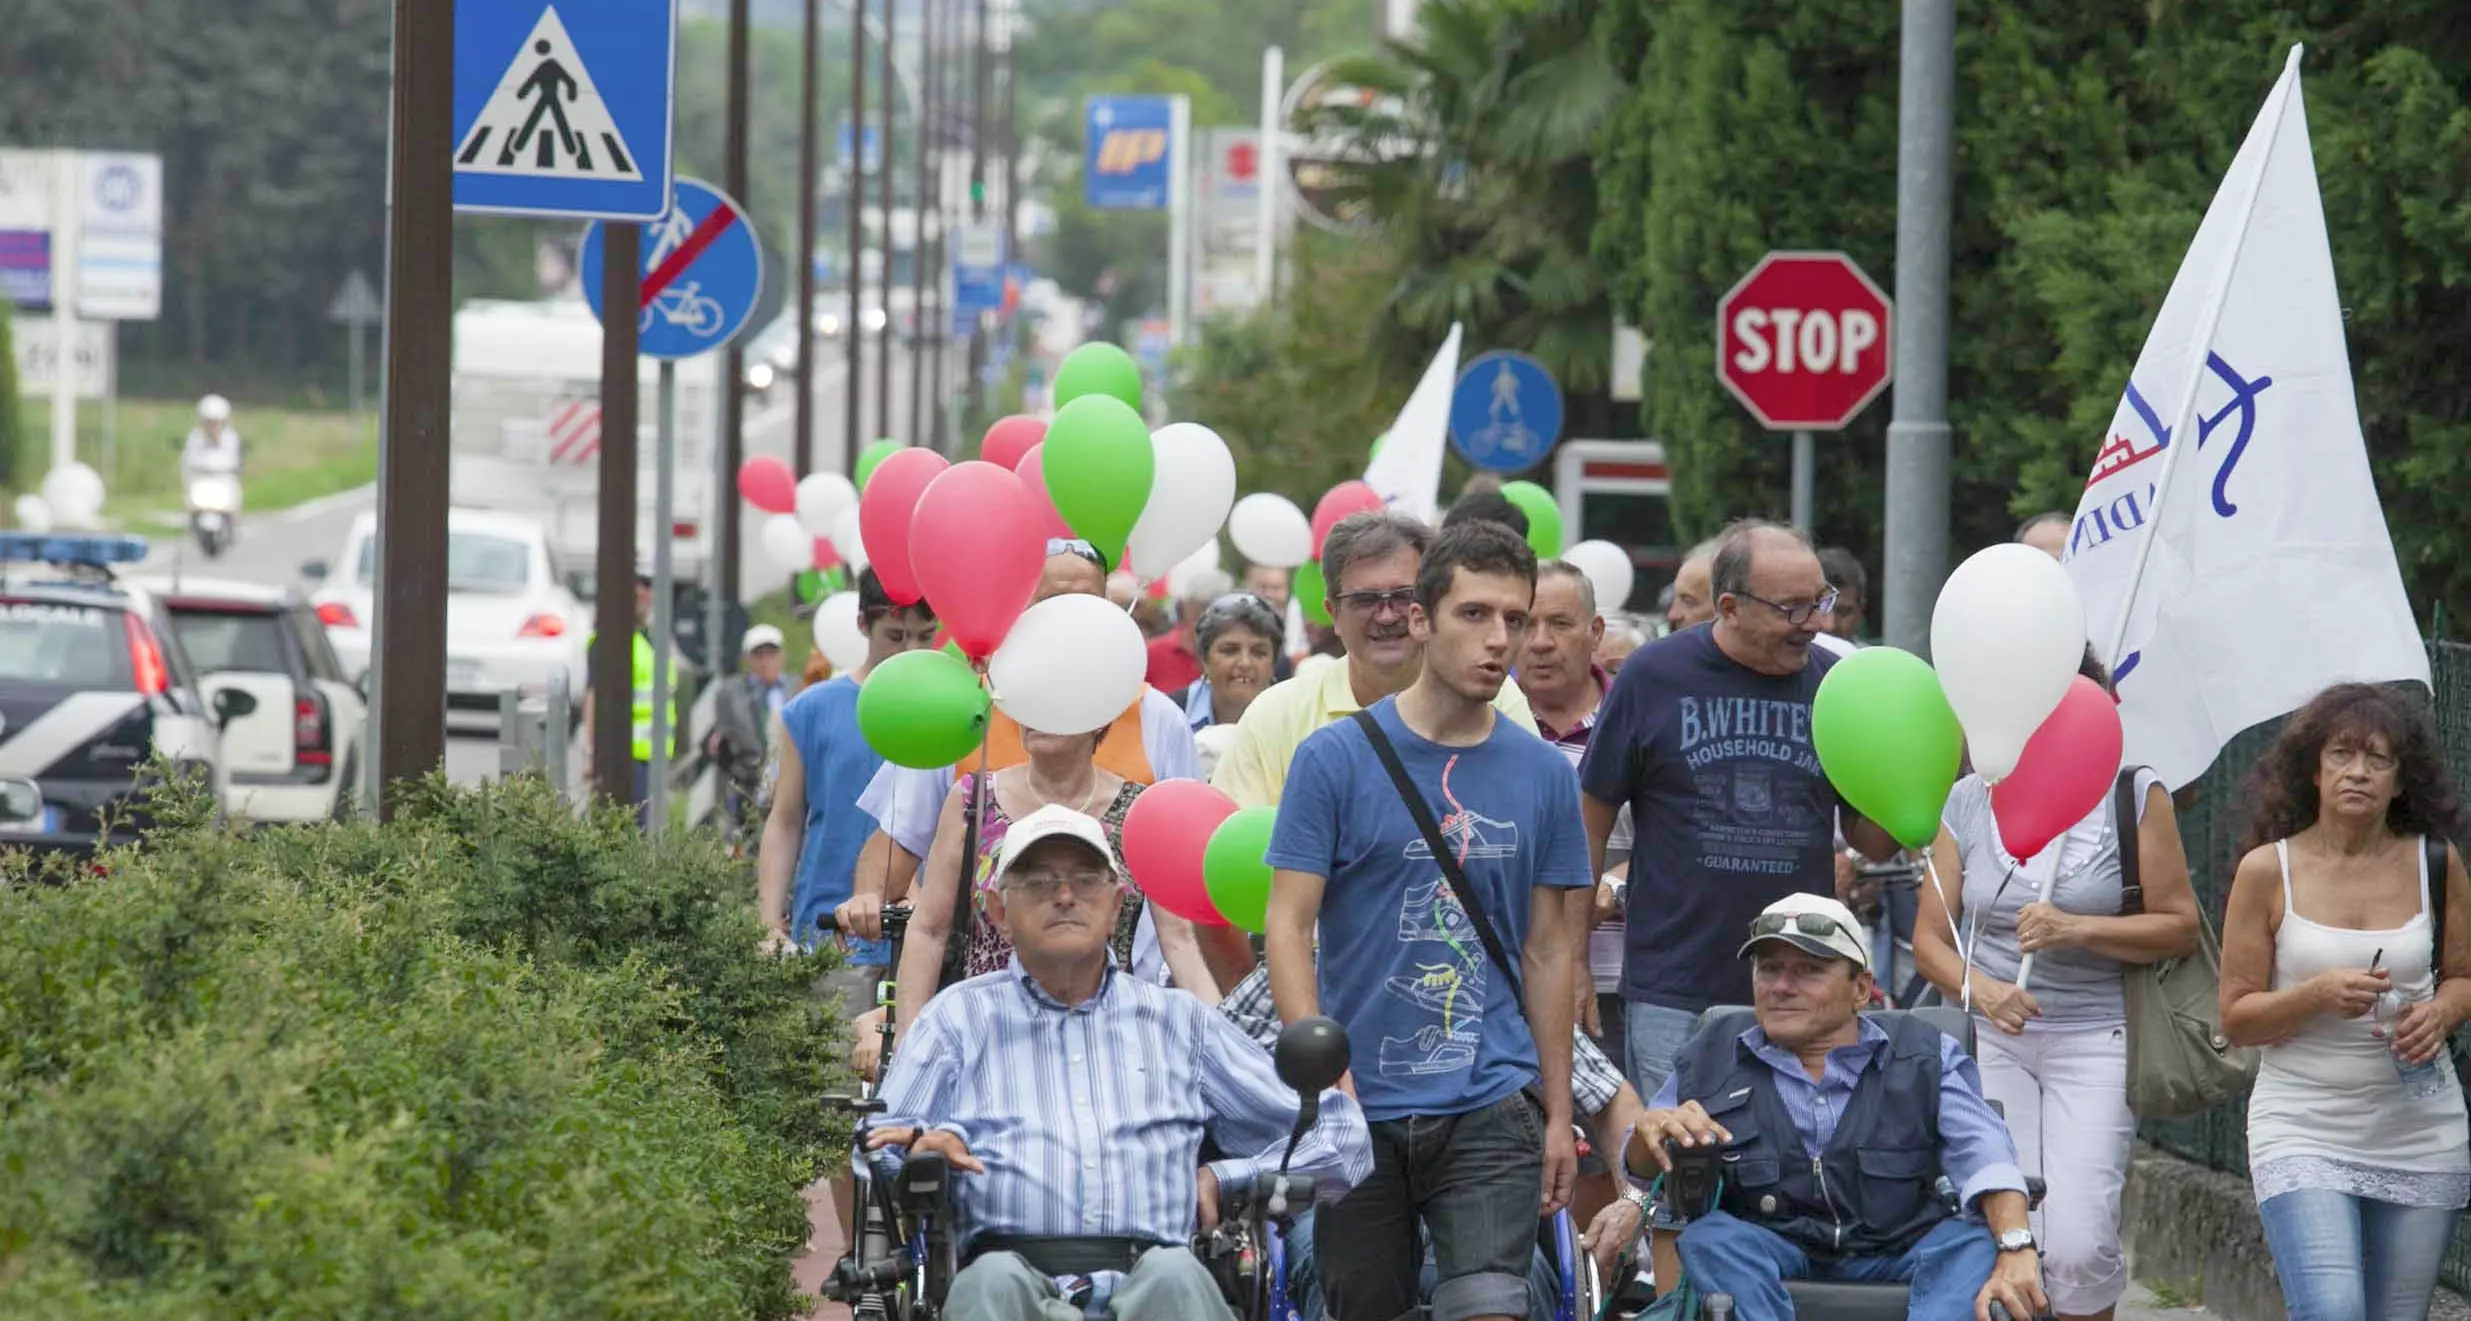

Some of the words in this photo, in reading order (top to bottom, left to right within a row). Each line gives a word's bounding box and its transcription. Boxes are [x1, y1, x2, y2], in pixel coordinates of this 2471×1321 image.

[1733, 306, 1878, 375] STOP
[1679, 696, 1812, 751] B.WHITE
[1685, 739, 1792, 771] HOUSEHOLD
